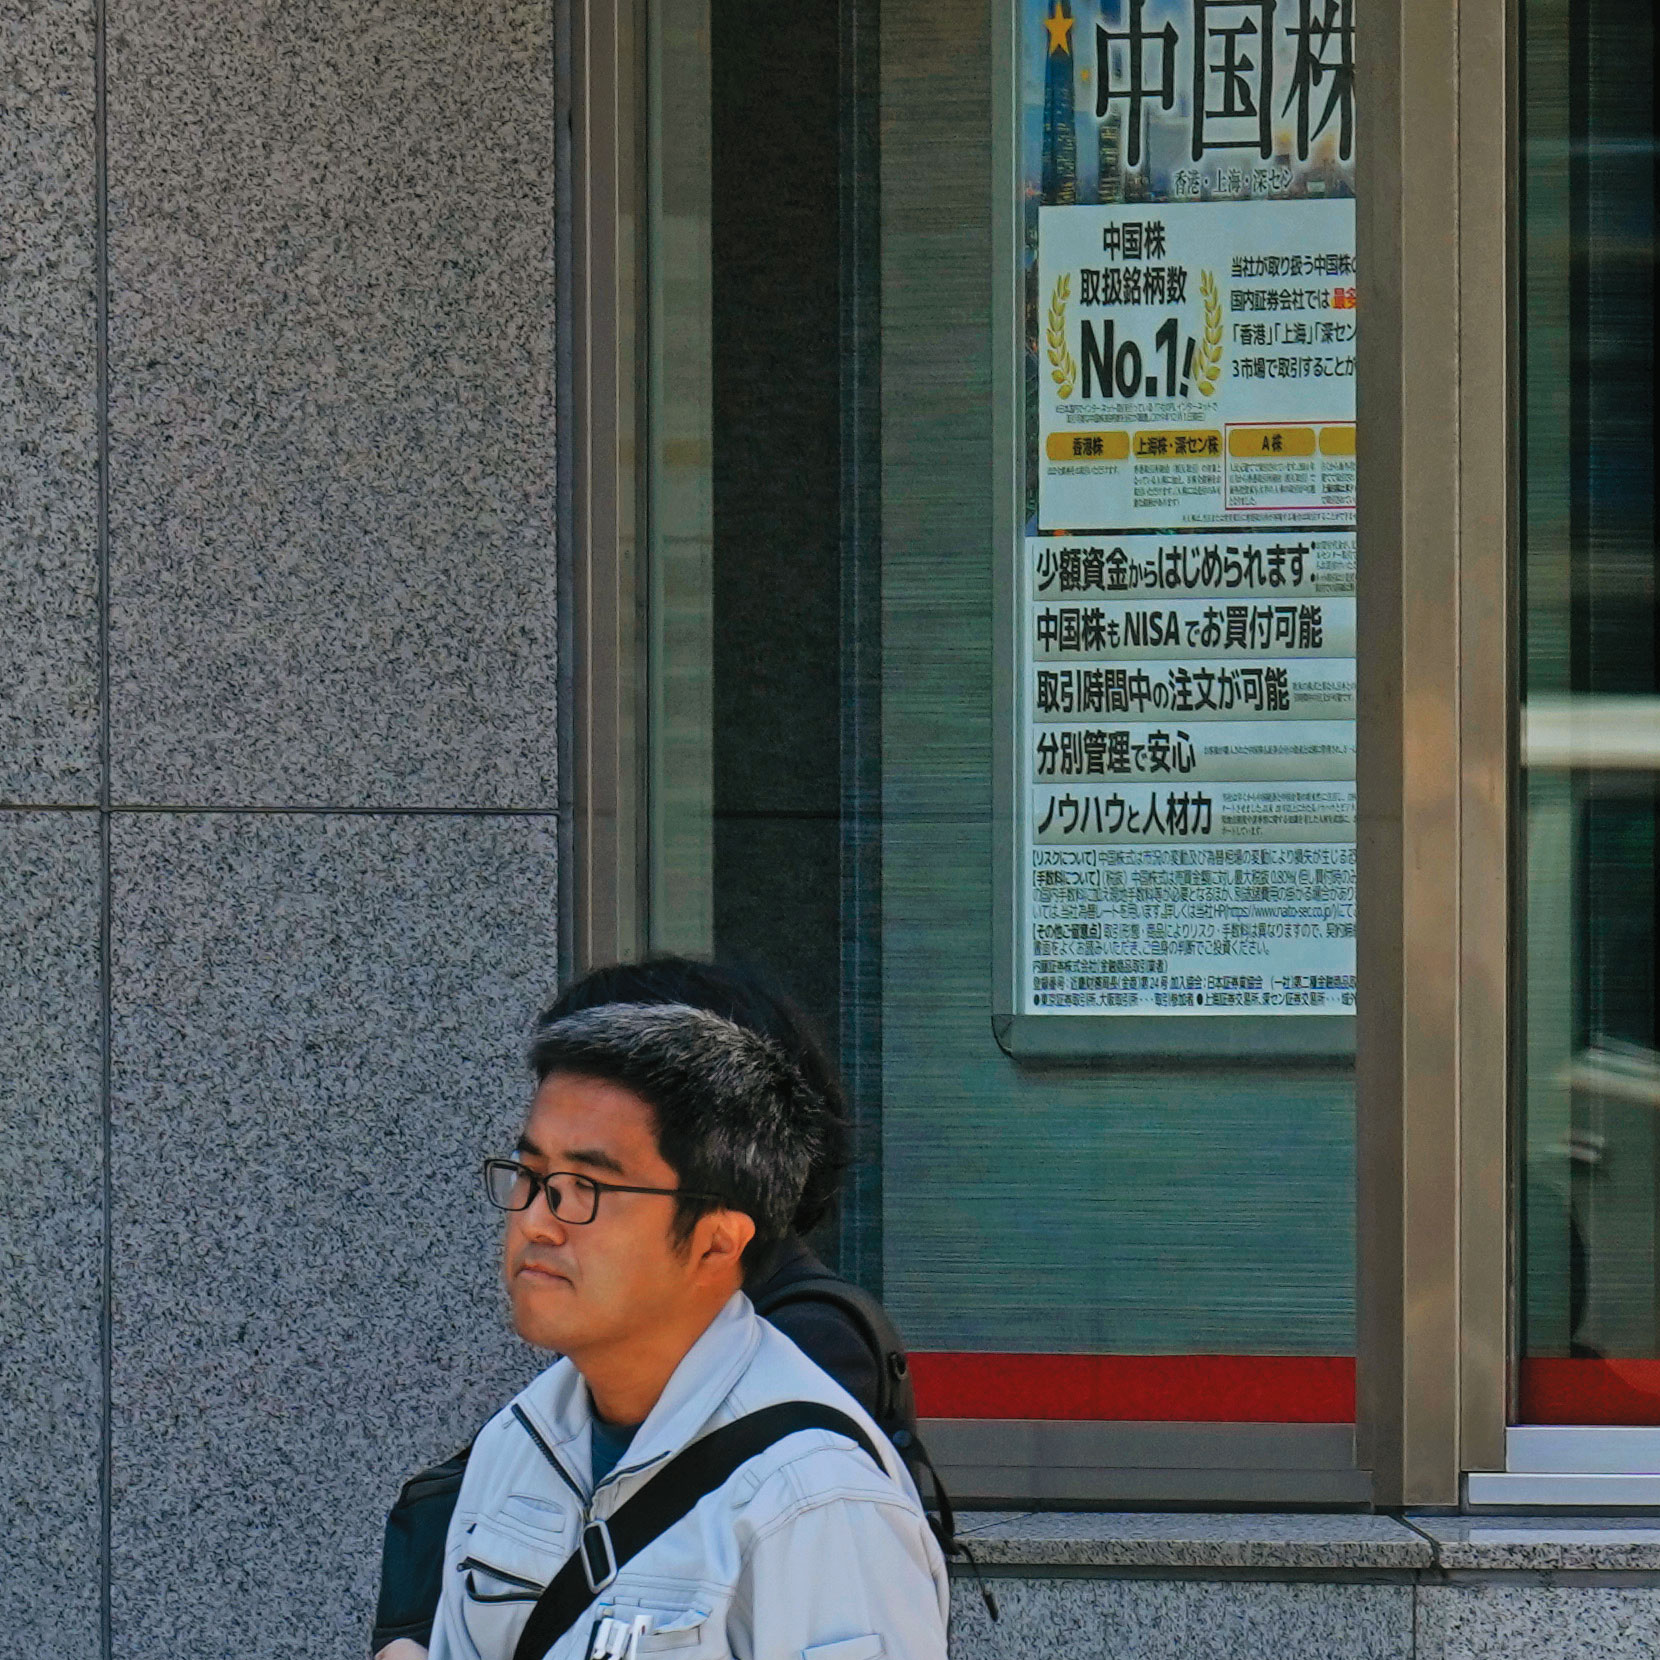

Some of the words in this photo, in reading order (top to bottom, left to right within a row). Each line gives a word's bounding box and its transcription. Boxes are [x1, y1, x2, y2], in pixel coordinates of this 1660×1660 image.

[1095, 0, 1356, 168] 中国株
[1102, 220, 1166, 262] 中国株
[1079, 265, 1188, 308] 取扱銘柄数
[1080, 317, 1197, 399] No.1!
[1036, 541, 1311, 593] 少額資金からはじめられます
[1036, 665, 1290, 714] 取引時間中の注文が可能
[1036, 728, 1197, 776] 分別管理で安心
[1036, 790, 1213, 837] ノウハウと人材力
